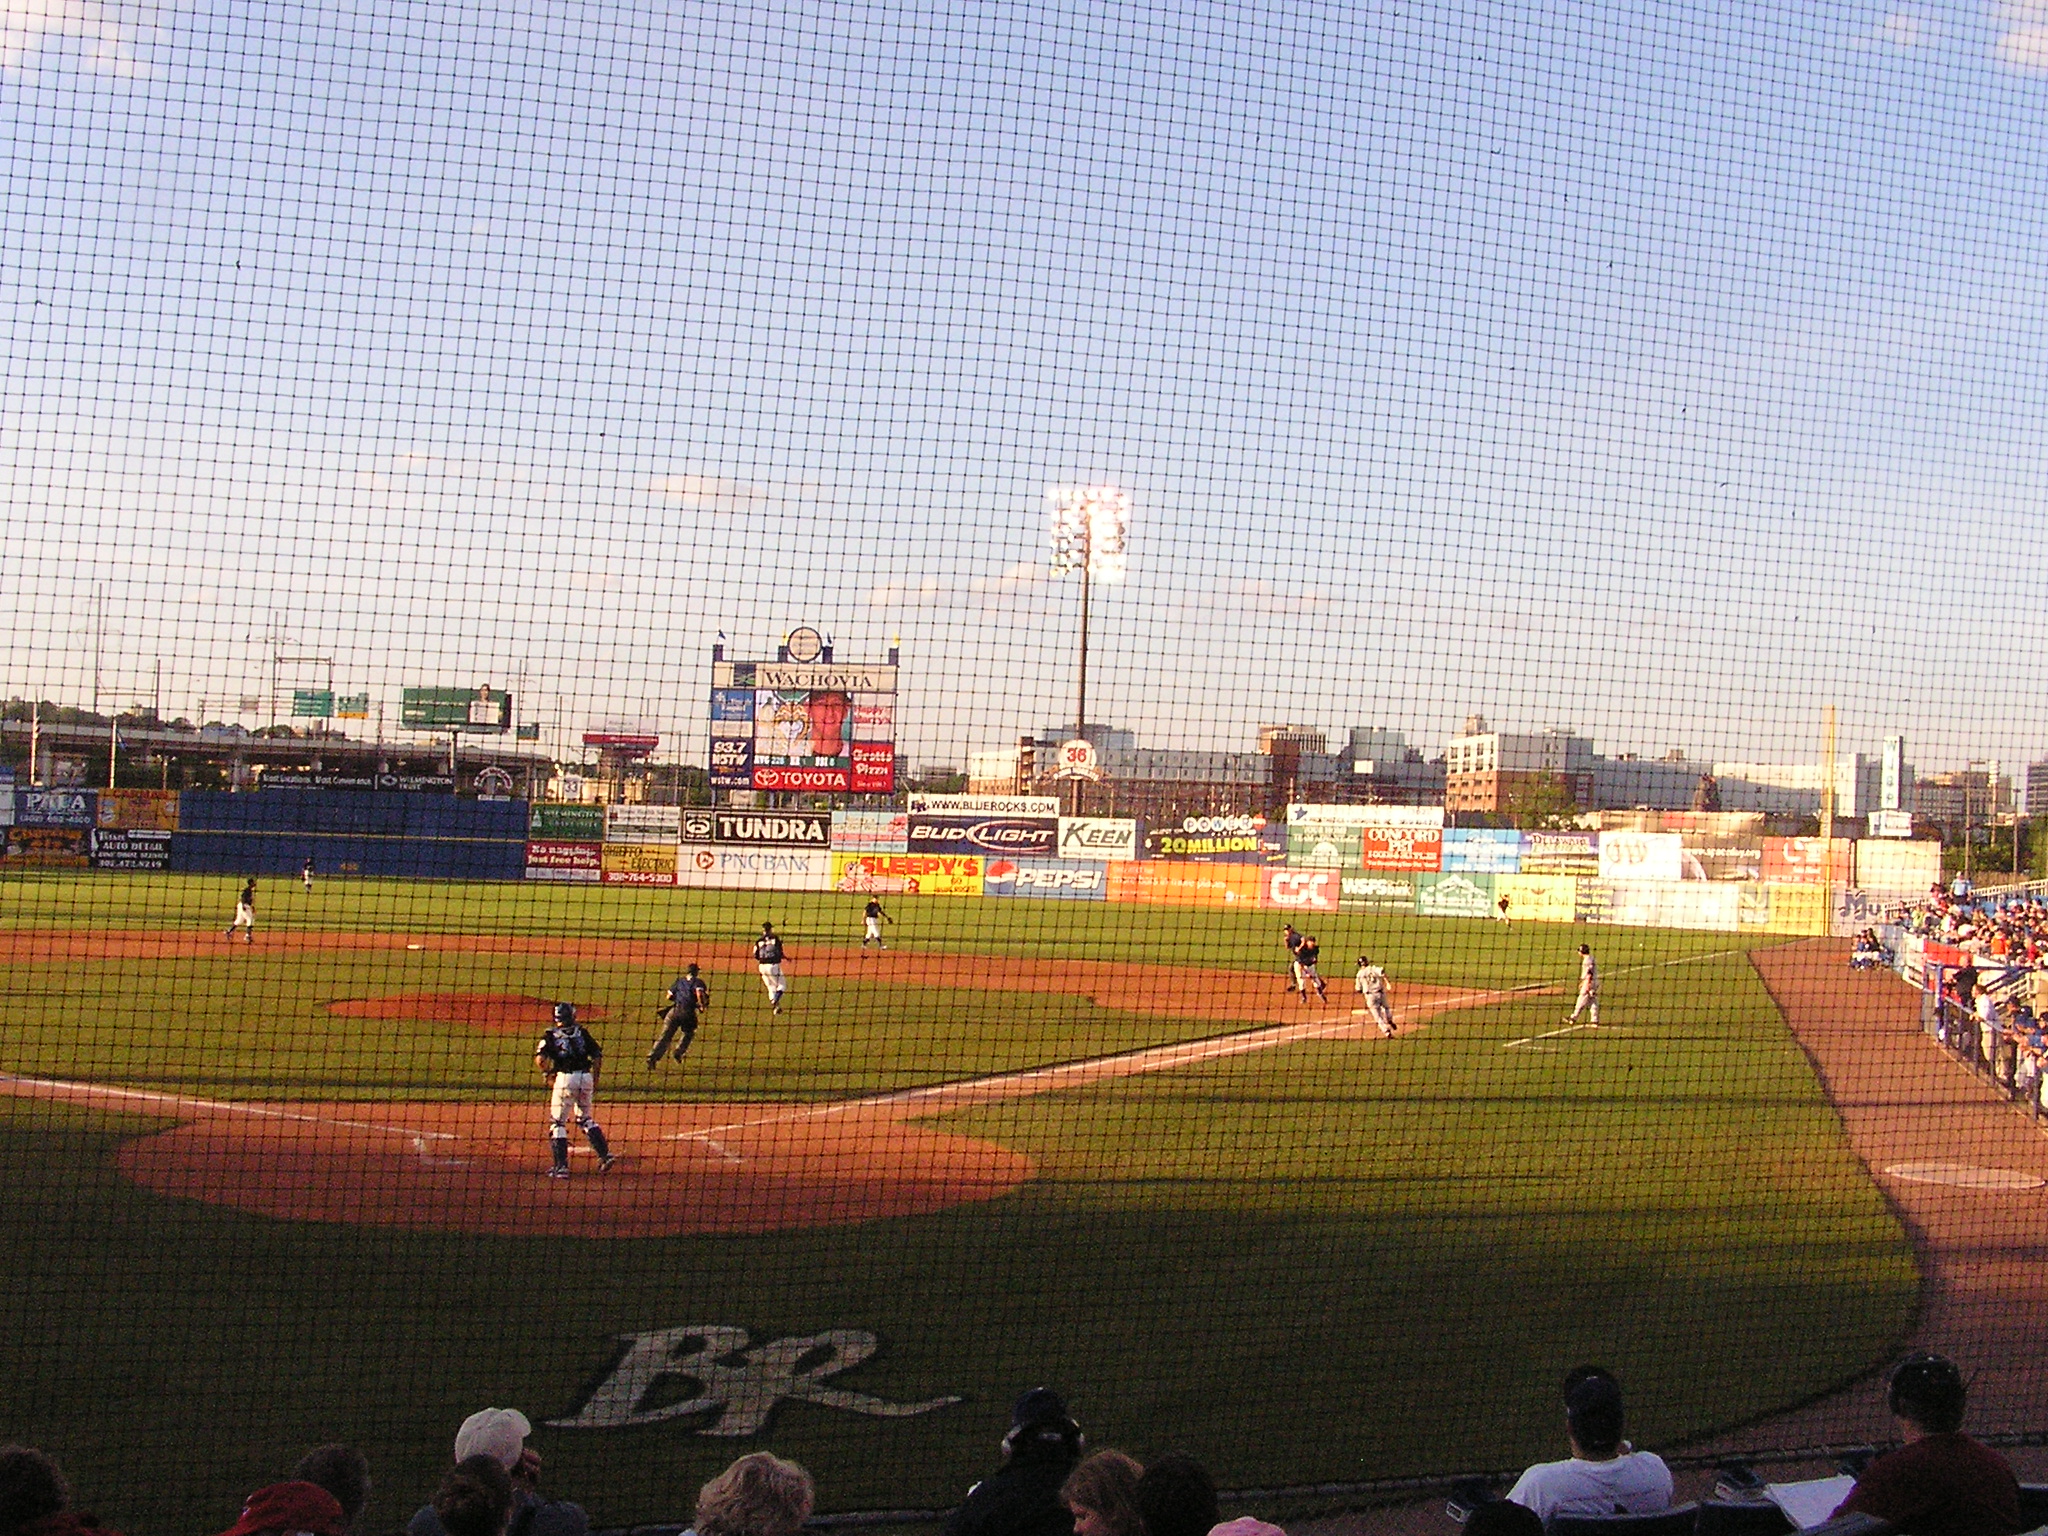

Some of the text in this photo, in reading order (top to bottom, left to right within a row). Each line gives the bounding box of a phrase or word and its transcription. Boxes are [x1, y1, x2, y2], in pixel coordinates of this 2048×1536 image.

[766, 671, 872, 687] WACHOVIA
[714, 741, 747, 754] 93.7
[565, 781, 579, 793] 33
[711, 776, 750, 786] wstw.com
[781, 772, 846, 787] TOYOTA
[932, 800, 1056, 814] WWW.BLUEROCKS.COM
[718, 818, 824, 841] TUNDRA
[910, 825, 966, 839] BUD
[978, 829, 1055, 843] LIGHT
[1062, 823, 1133, 847] KEEN
[1368, 828, 1440, 843] CONCORD
[1187, 837, 1258, 853] MILLION
[1388, 840, 1414, 853] PET
[631, 858, 676, 870] ELECTRIC
[860, 857, 978, 876] SLEEPY'S
[1016, 867, 1103, 889] PEPSI
[1342, 877, 1388, 895] WSFS
[1270, 872, 1329, 906] CSC
[541, 1325, 963, 1437] BR
